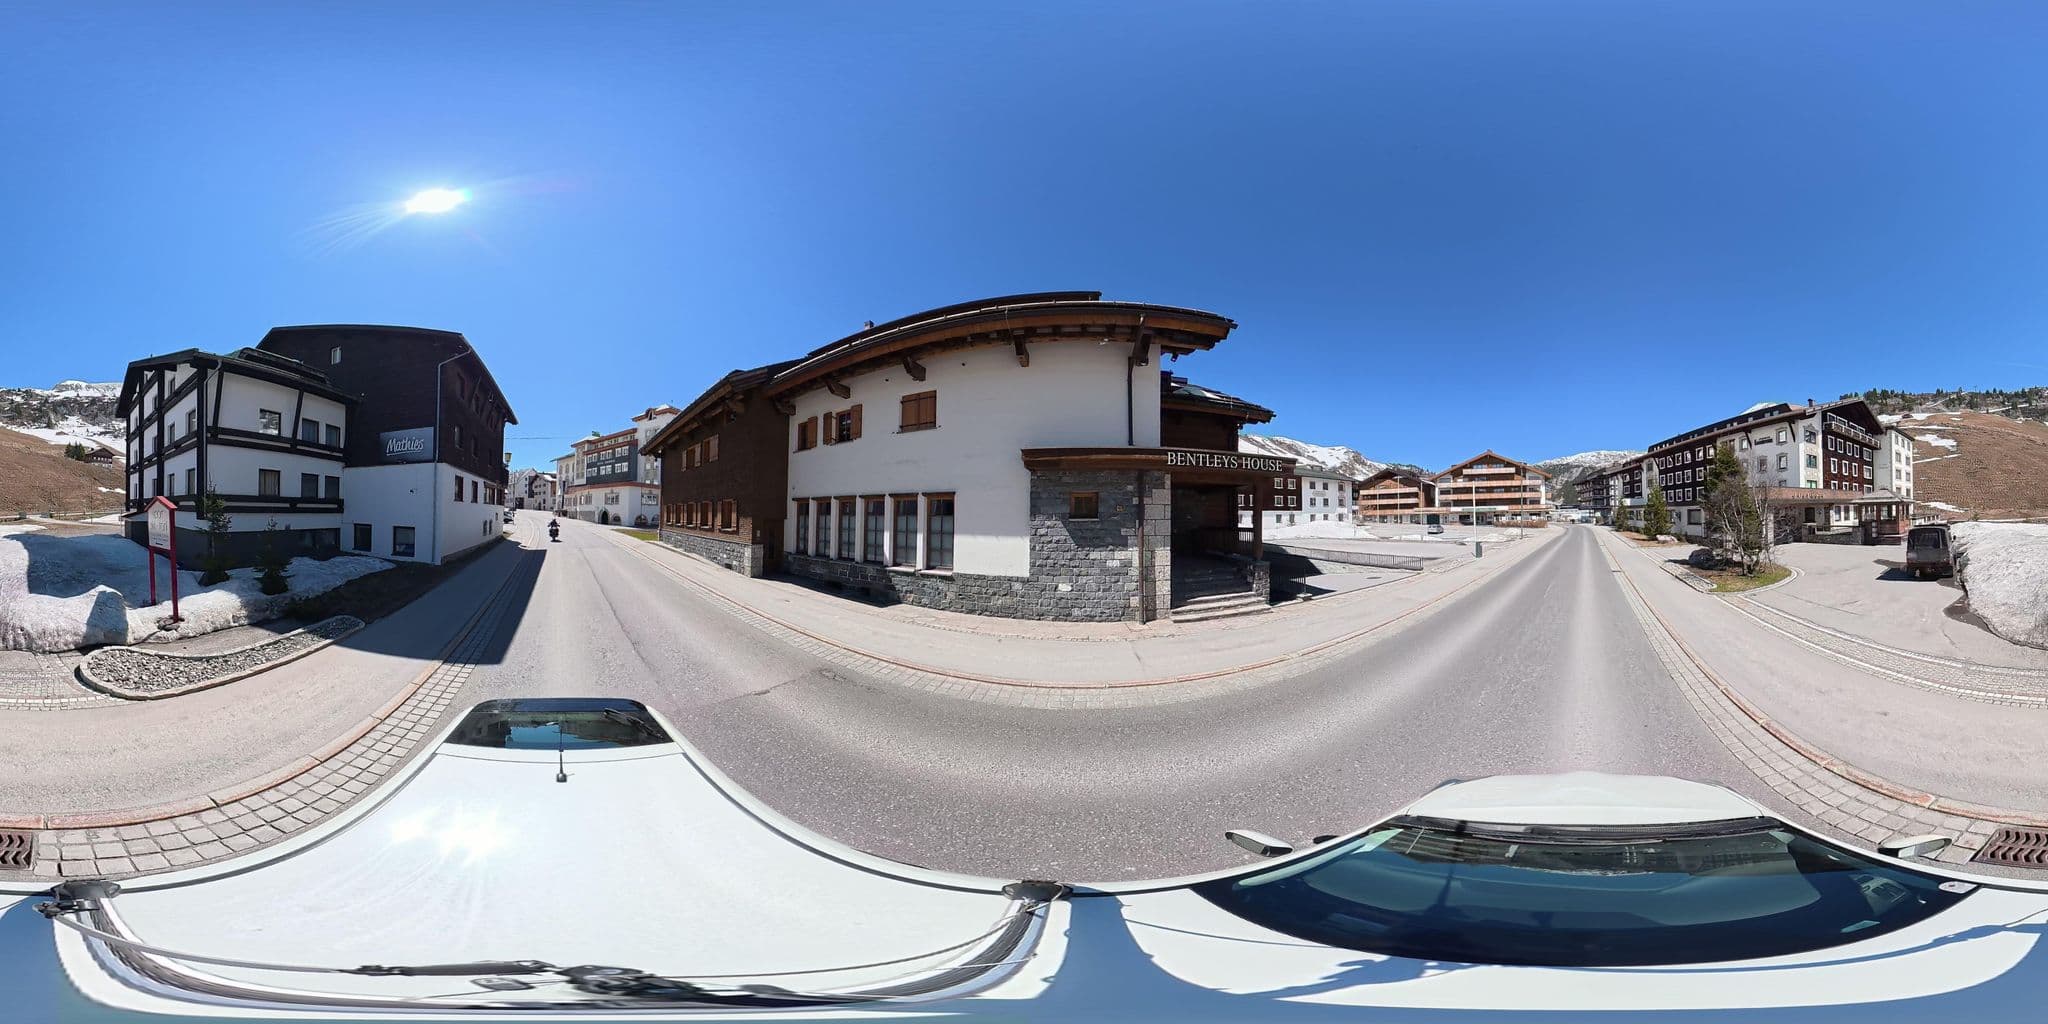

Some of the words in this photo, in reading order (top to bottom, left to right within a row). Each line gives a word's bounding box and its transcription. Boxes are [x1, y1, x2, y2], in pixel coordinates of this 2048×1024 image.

[386, 436, 424, 454] Mathies
[1167, 451, 1238, 469] BENTLEYS
[1242, 456, 1283, 472] HOUSE
